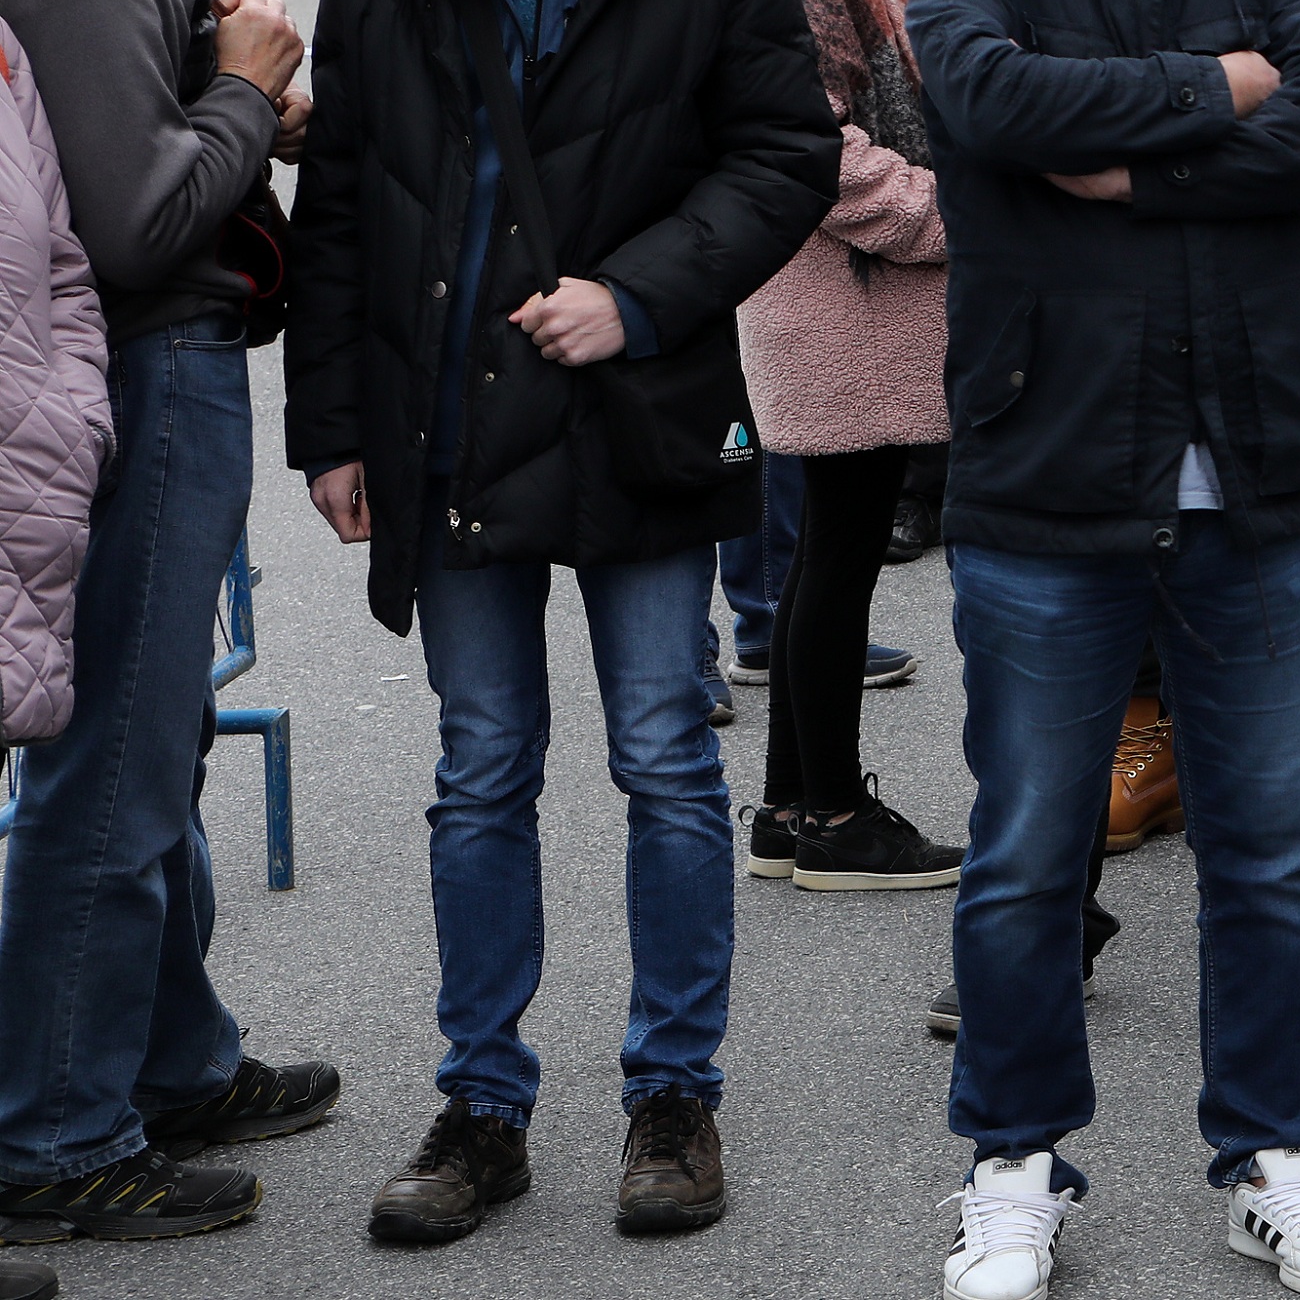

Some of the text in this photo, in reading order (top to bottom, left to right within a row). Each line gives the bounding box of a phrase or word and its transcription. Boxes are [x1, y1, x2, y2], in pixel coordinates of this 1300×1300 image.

[719, 447, 754, 459] ASCENSIA
[723, 456, 744, 464] Diabetes
[994, 1160, 1023, 1171] adidas
